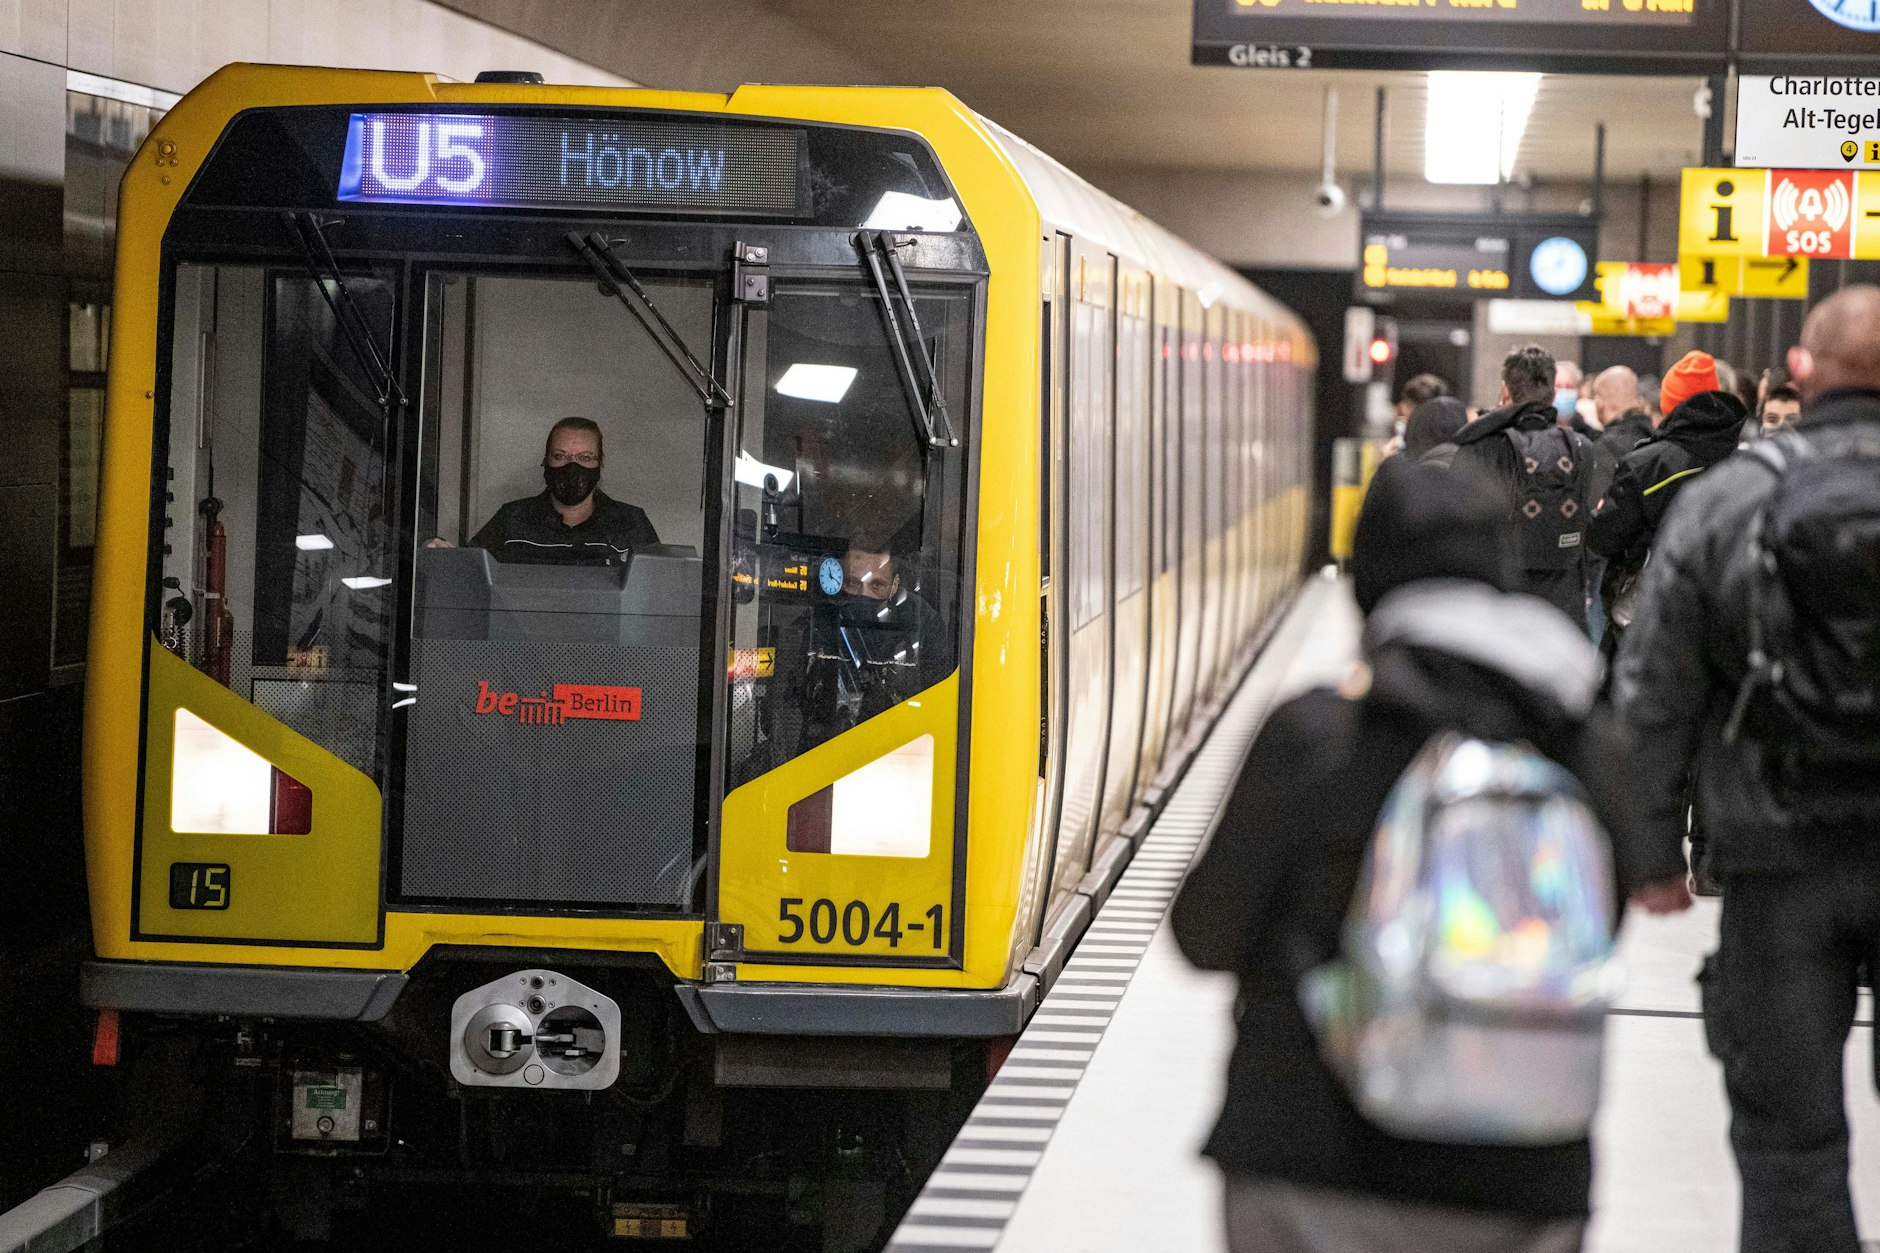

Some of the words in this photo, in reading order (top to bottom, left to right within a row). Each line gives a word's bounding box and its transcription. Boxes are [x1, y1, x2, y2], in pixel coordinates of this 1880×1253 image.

[1228, 44, 1290, 67] Gleis
[1296, 46, 1312, 68] 2
[370, 119, 486, 194] U5
[560, 131, 726, 191] Hönow
[1846, 144, 1853, 154] 4
[1786, 230, 1831, 253] SOS
[475, 680, 518, 715] be
[570, 693, 632, 713] Berlin
[190, 867, 227, 907] 15
[778, 897, 943, 949] 5004-1
